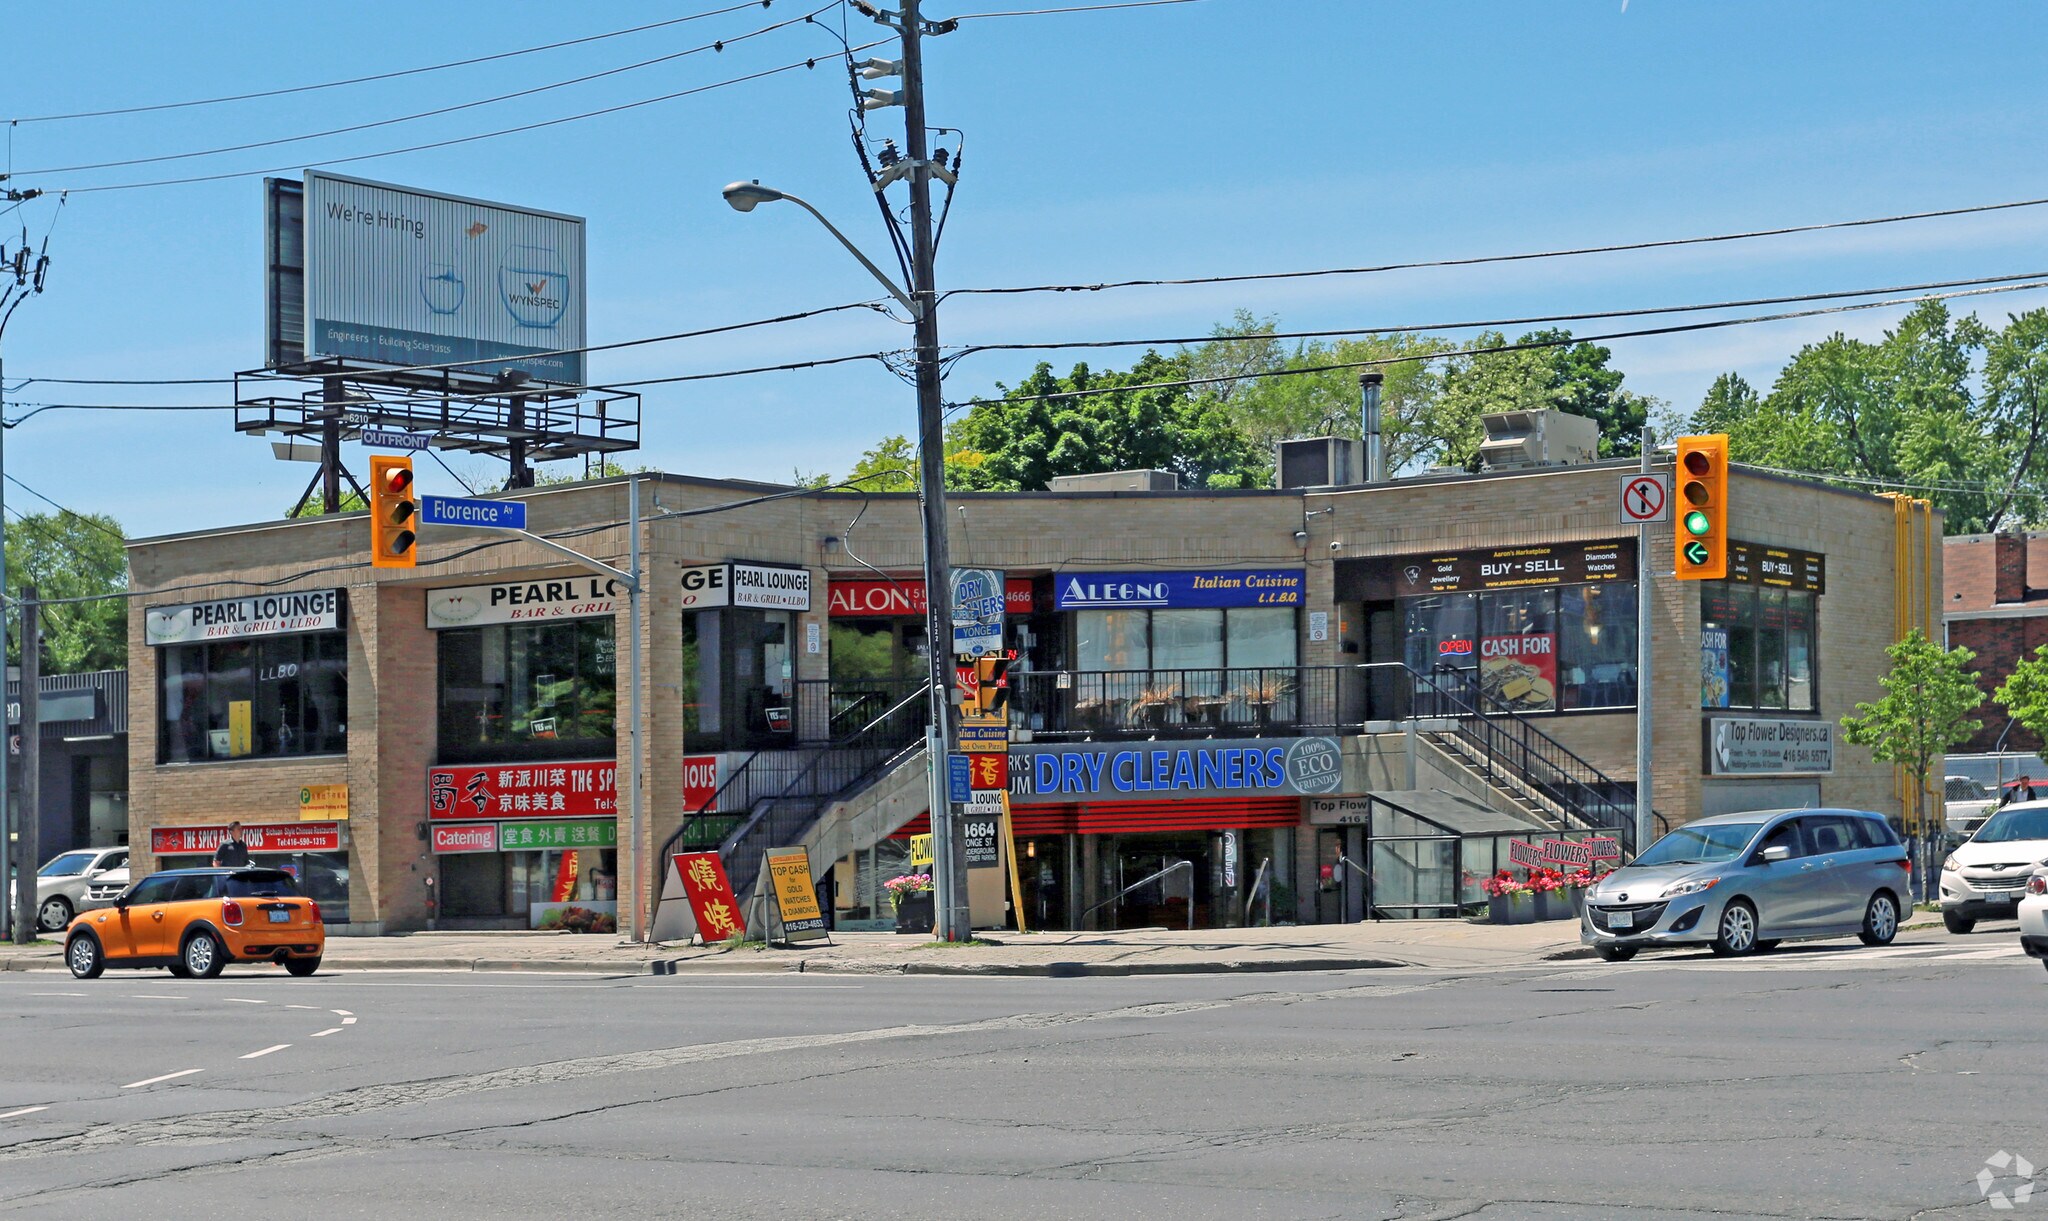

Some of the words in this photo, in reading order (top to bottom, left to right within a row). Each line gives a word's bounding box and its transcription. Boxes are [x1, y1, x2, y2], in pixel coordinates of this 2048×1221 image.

[327, 202, 374, 225] We're
[379, 210, 424, 239] Hiring
[509, 293, 560, 309] WYNSPEC
[328, 328, 369, 343] Engineers
[379, 334, 411, 351] Building
[412, 339, 451, 354] Scientists
[349, 413, 369, 423] 6210
[363, 431, 427, 449] OUTFRONT
[434, 500, 498, 522] Florence
[1493, 550, 1515, 558] Aaron's
[1516, 548, 1551, 557] Marketplace
[1585, 552, 1617, 561] Diamonds
[1437, 565, 1453, 573] Gold
[1481, 562, 1512, 576] BUY
[1525, 559, 1565, 573] SELL
[1587, 563, 1615, 571] Watches
[1762, 561, 1775, 573] BUY
[1779, 563, 1793, 576] SELL
[681, 568, 723, 591] GE
[735, 569, 765, 588] PEARL
[768, 572, 808, 591] LOUNGE
[1061, 577, 1169, 600] ALEGNO
[1193, 576, 1241, 588] Italian
[1245, 575, 1298, 588] Cuisine
[1430, 575, 1460, 584] Jewellery
[491, 581, 579, 606] PEARL
[960, 578, 983, 601] DRY
[738, 592, 752, 603] BAR
[760, 594, 782, 605] GRILL
[787, 596, 807, 606] LLBO
[192, 601, 247, 627] PEARL
[254, 593, 336, 620] LOUNGE
[510, 606, 546, 619] BAR
[552, 606, 564, 616] &
[208, 625, 229, 637] BAR
[232, 625, 240, 635] &
[243, 620, 278, 633] GRILL
[289, 616, 322, 629] LLBO
[963, 625, 992, 637] YONGE
[1439, 640, 1473, 653] OPEN
[1481, 638, 1519, 656] CASH
[1522, 637, 1551, 655] FOR
[1715, 632, 1727, 649] FOR
[978, 728, 1006, 738] Cuisine
[1731, 721, 1746, 745] Top
[1749, 722, 1777, 740] Flower
[1779, 722, 1828, 746] Designers.ca
[1300, 742, 1326, 755] 100%
[1783, 750, 1796, 762] 416
[1811, 750, 1828, 762] 5577
[1034, 752, 1107, 794] DRY
[1111, 746, 1286, 792] CLEANERS
[1297, 754, 1333, 776] ECO
[498, 769, 566, 788] 新派川菜
[572, 769, 592, 792] THE
[684, 764, 715, 788] IOUS
[1299, 772, 1339, 790] FRIENDLY
[498, 791, 566, 812] 京味美食
[1314, 801, 1335, 812] Top
[1340, 815, 1361, 824] 416
[183, 830, 196, 849] THE
[198, 829, 218, 849] SPICY
[265, 827, 283, 836] Sichuan
[284, 827, 296, 837] Style
[296, 826, 314, 836] Chinese
[437, 830, 492, 847] Catering
[1511, 842, 1543, 867] FLOWERS
[1544, 841, 1590, 864] FLOWERS
[1587, 840, 1617, 856] OWERS
[772, 867, 788, 877] TOP
[788, 865, 809, 875] CASH
[786, 885, 803, 893] GOLD
[783, 896, 811, 905] WATCHES
[788, 906, 818, 916] DIAMONDS
